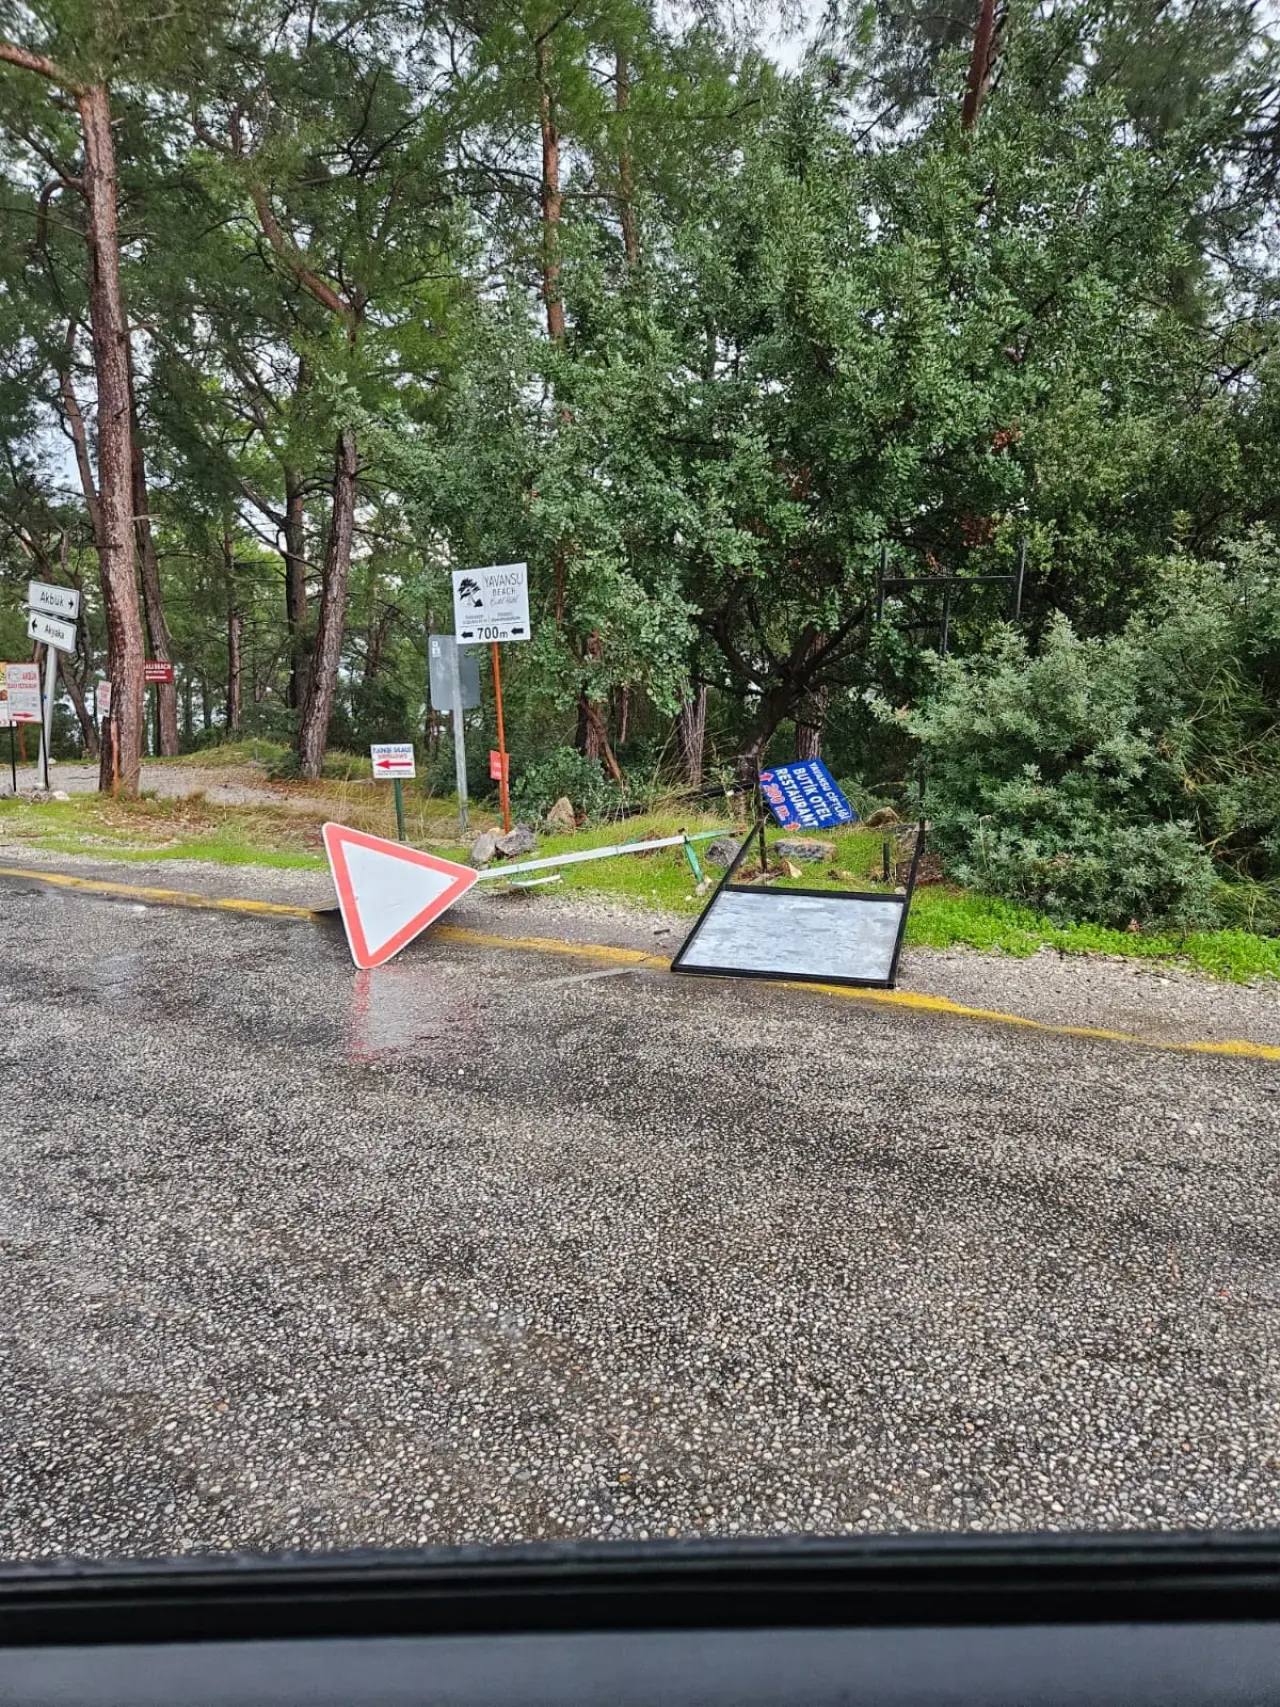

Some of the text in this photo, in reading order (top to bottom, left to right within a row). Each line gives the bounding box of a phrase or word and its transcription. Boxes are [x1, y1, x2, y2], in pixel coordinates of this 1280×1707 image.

[483, 572, 524, 588] YAVANSU
[492, 587, 516, 597] BEACH
[808, 762, 832, 792] YAVANSU
[774, 768, 819, 827] RESTAURANT
[809, 796, 833, 821] OTEL
